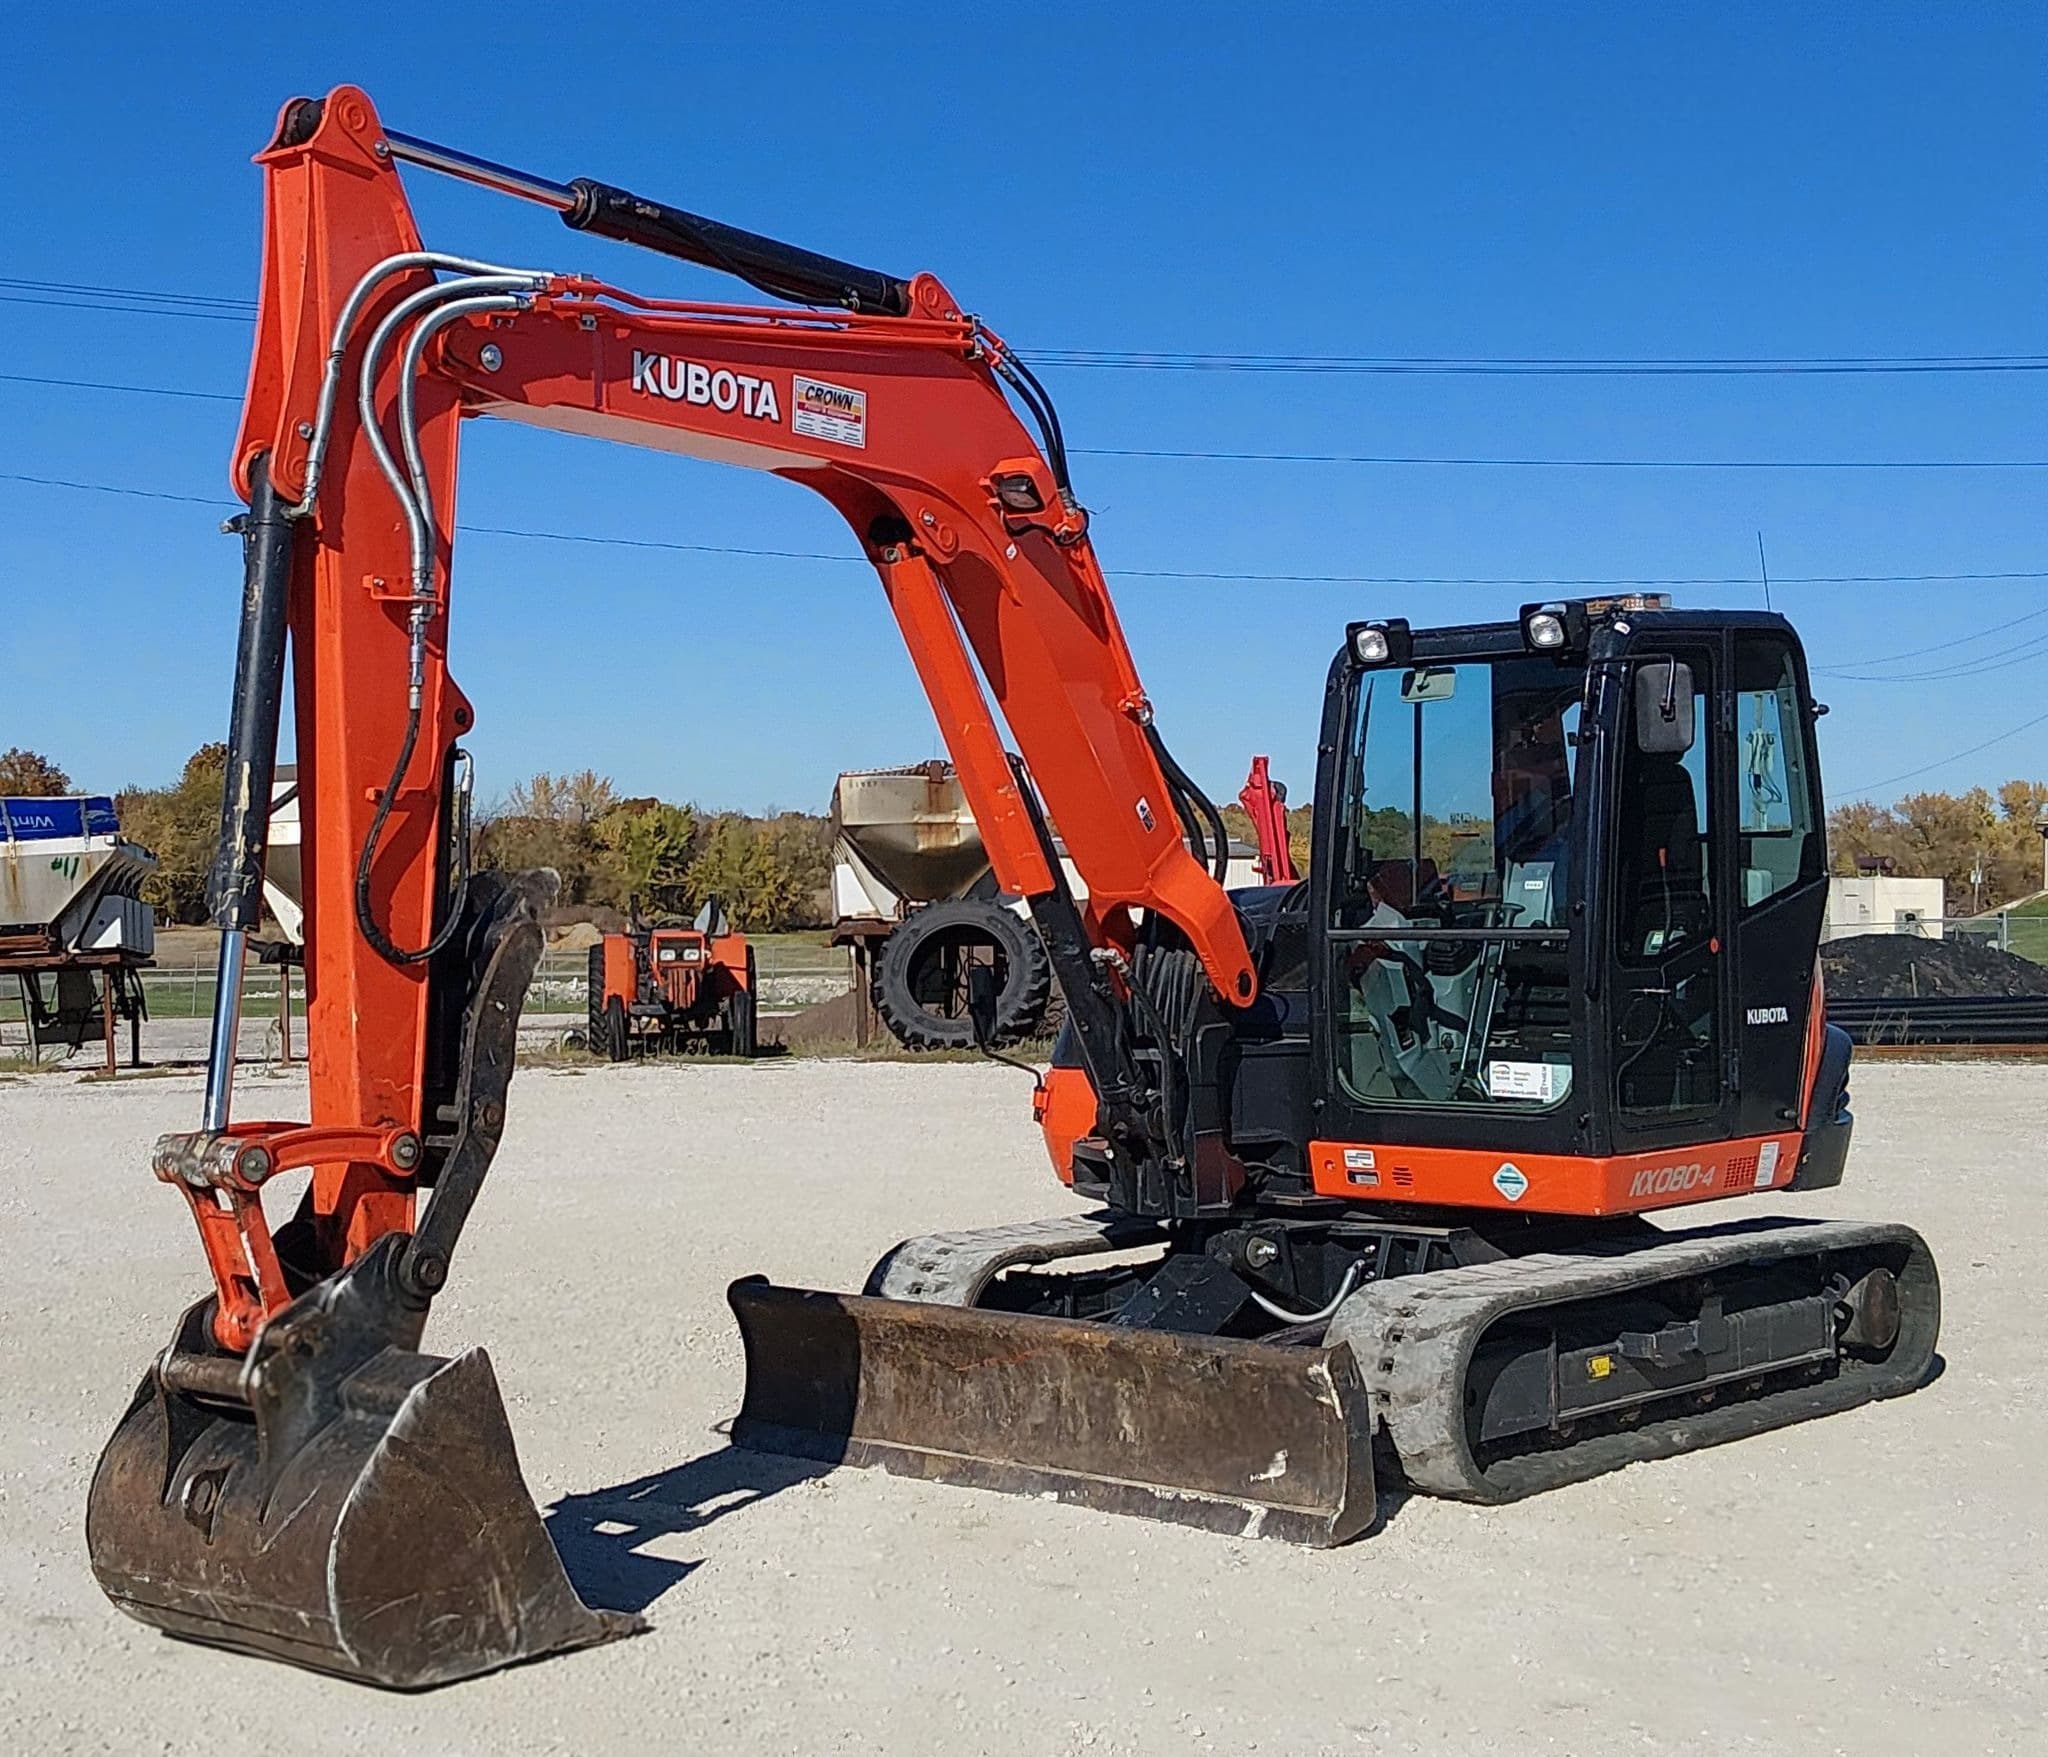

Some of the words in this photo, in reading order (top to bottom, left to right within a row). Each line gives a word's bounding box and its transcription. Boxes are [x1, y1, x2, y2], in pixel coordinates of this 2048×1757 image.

[632, 350, 780, 422] KUBOTA
[804, 385, 855, 411] CROWN
[51, 856, 80, 881] #11
[1746, 1006, 1789, 1025] KUBOTA
